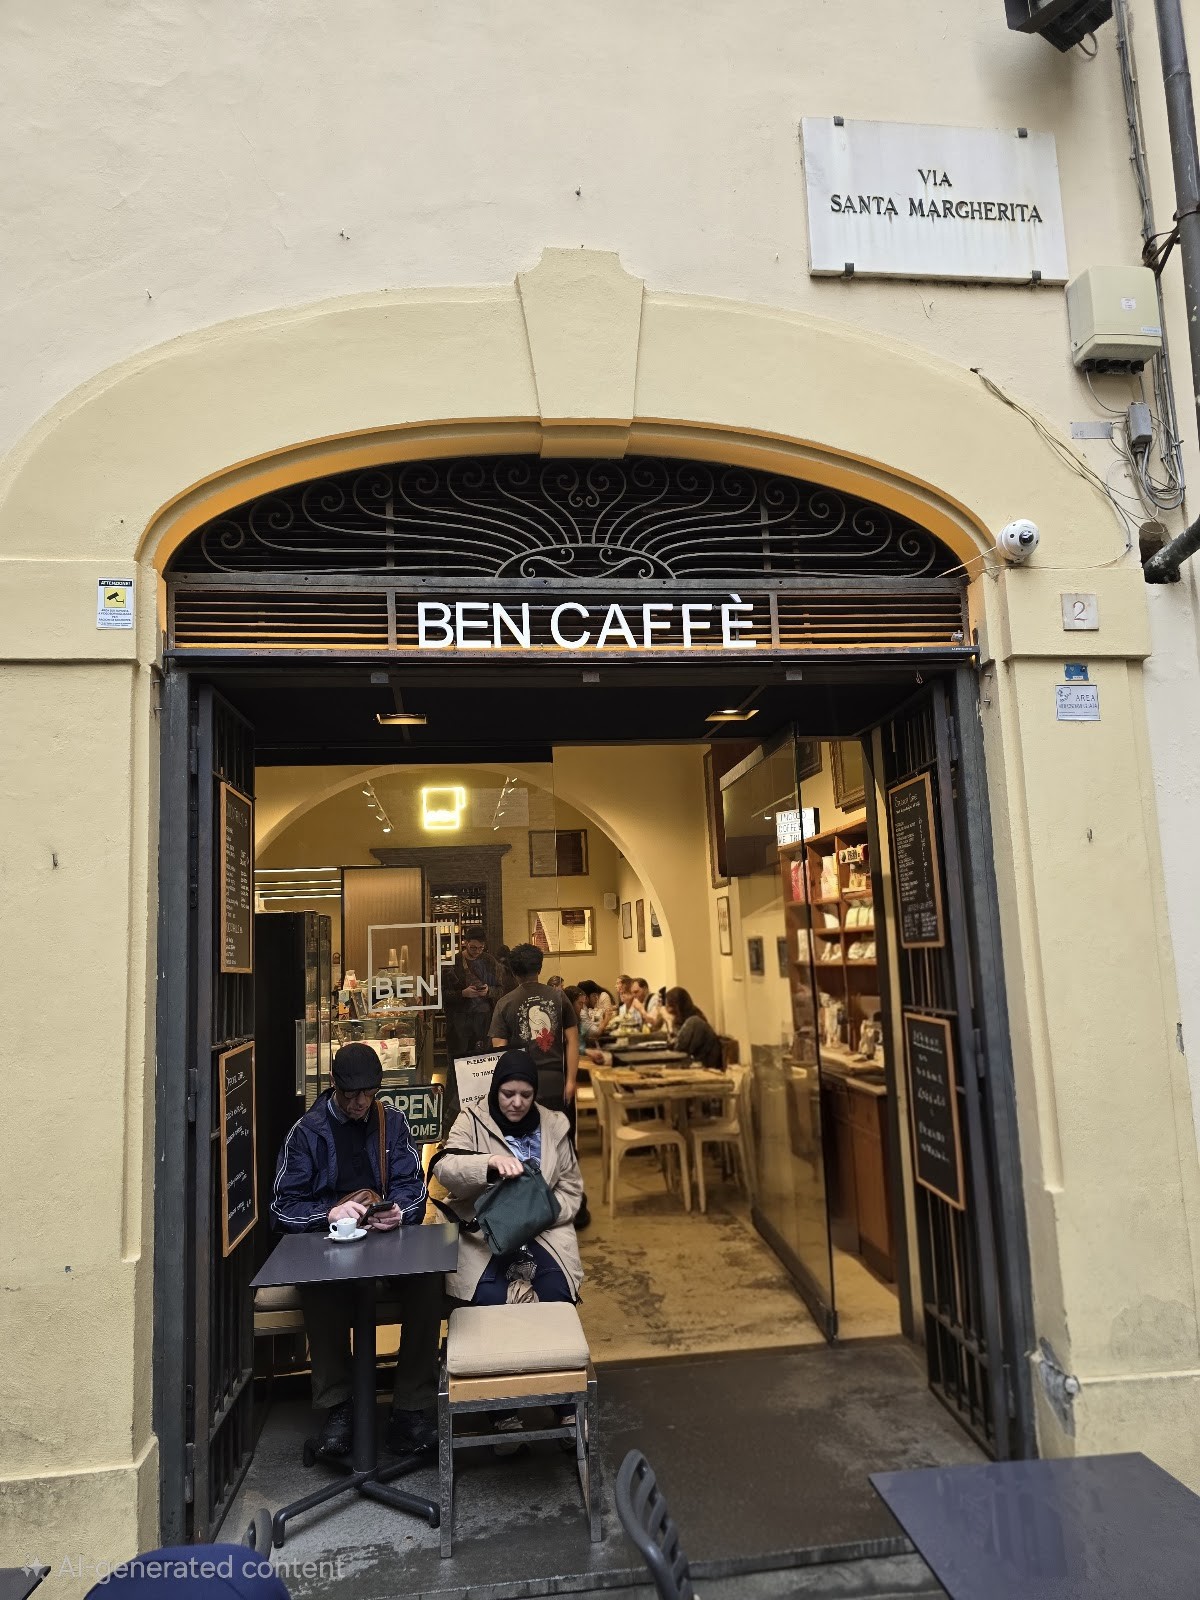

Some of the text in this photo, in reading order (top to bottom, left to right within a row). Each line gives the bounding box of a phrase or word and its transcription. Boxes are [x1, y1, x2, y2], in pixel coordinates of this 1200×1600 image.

[918, 169, 952, 187] VIA
[830, 194, 1043, 223] SANTA MARGHERITA
[417, 593, 757, 649] BEN CAFFÈ
[1072, 600, 1088, 621] 2
[1076, 694, 1096, 702] AREA
[375, 975, 435, 1000] BEN
